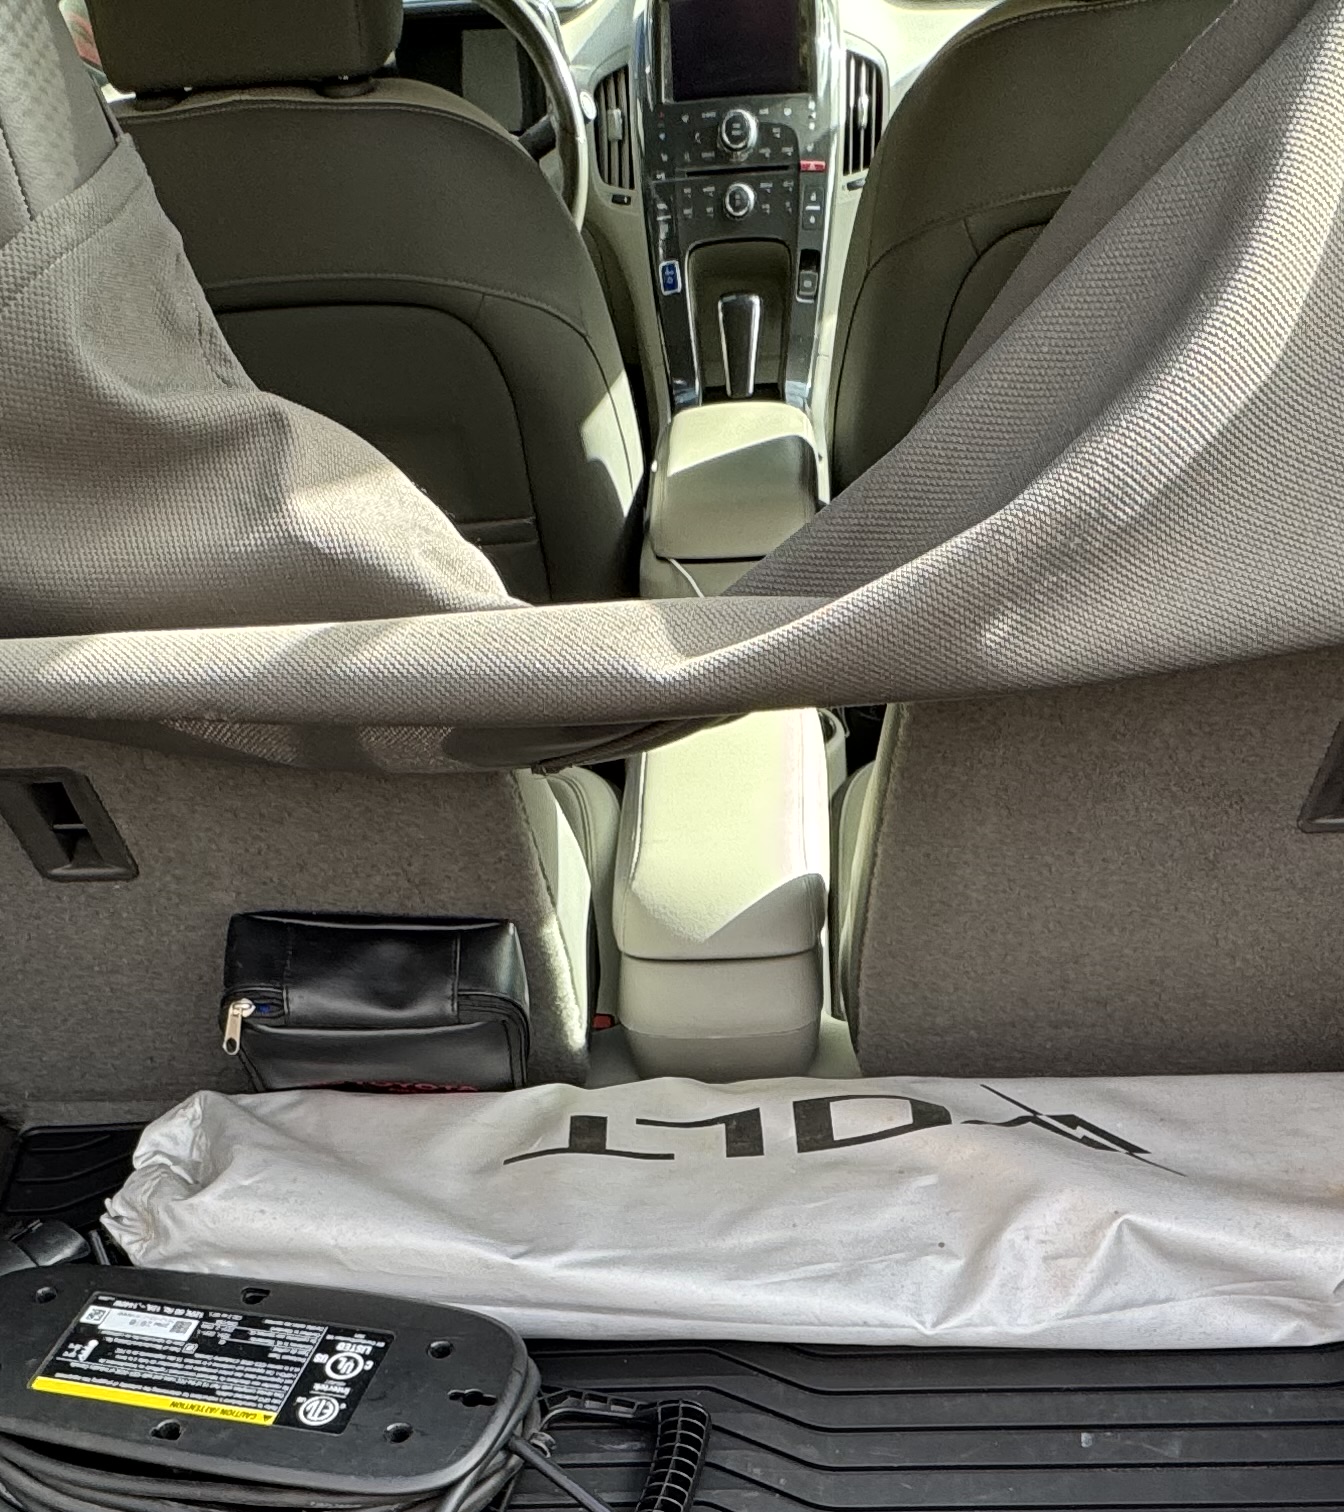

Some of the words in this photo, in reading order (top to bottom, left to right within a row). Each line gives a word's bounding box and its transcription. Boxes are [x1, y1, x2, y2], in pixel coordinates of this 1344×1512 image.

[503, 1084, 1186, 1177] VOLT
[335, 1341, 372, 1355] LISTED
[313, 1353, 329, 1364] US
[336, 1356, 355, 1374] UL
[313, 1382, 351, 1395] Intertek
[220, 1408, 258, 1421] CAUTION
